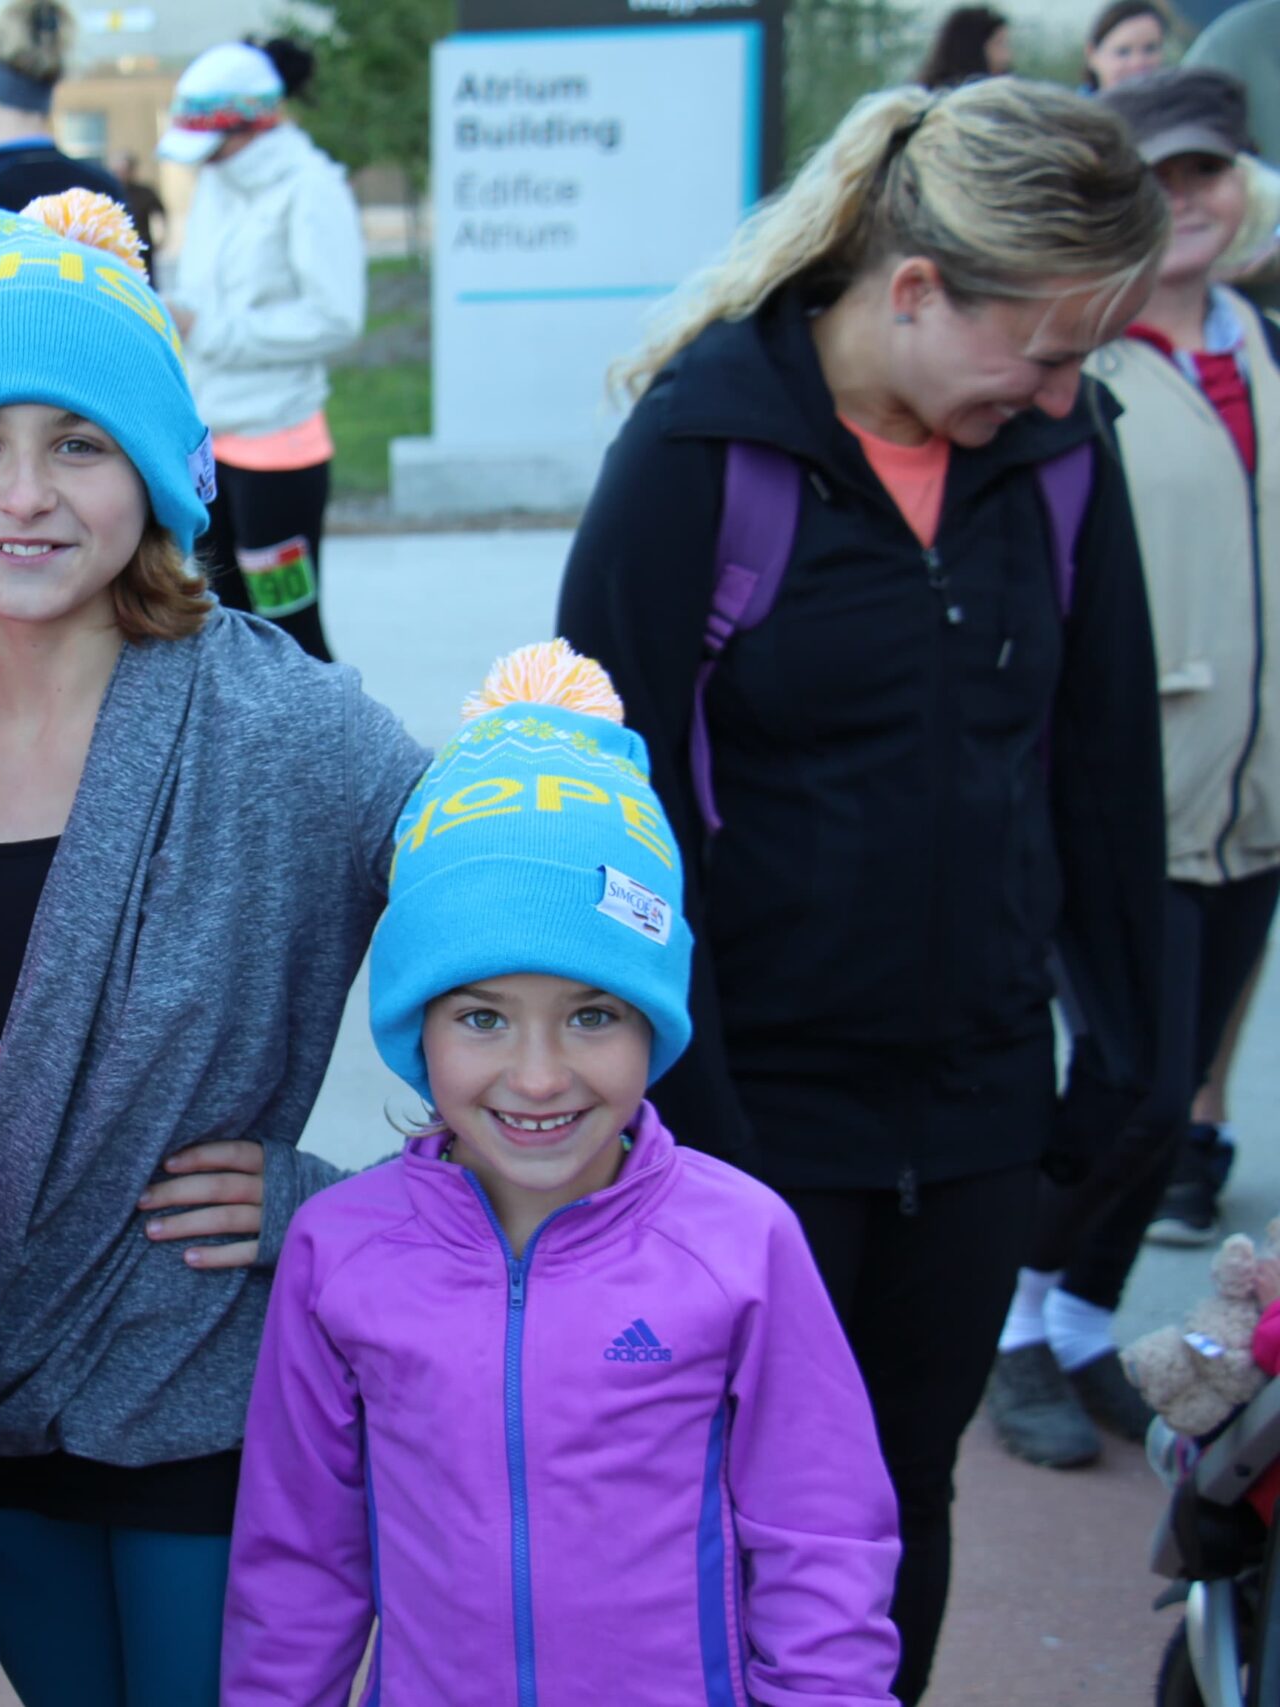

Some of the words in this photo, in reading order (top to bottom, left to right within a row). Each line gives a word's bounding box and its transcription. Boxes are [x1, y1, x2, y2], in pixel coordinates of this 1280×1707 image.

[454, 71, 591, 103] Atrium
[455, 114, 623, 154] Building
[453, 217, 577, 251] Atrium
[608, 880, 652, 914] SIMCOE
[603, 1345, 672, 1362] adidas
